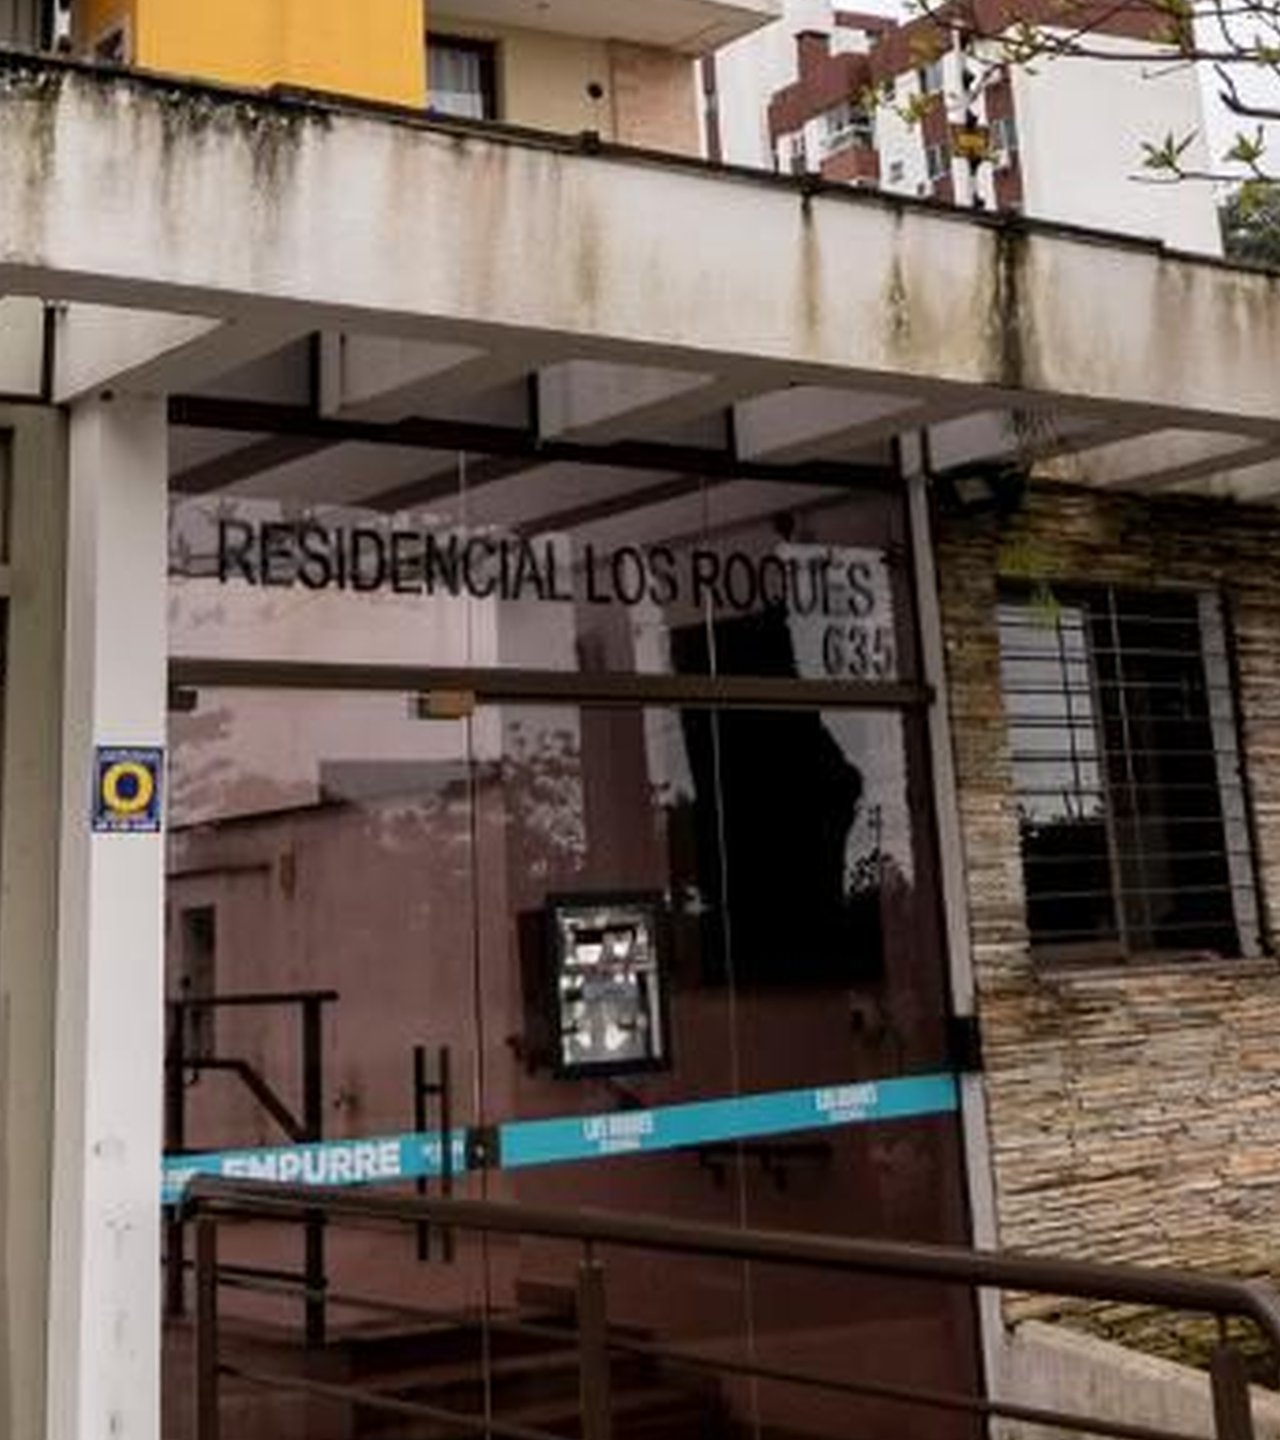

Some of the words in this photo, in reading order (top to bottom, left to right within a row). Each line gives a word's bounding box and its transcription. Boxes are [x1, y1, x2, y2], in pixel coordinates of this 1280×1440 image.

[219, 519, 573, 602] RESIDENCIAL
[585, 543, 678, 605] LOS
[691, 550, 874, 617] ROQUES
[823, 624, 894, 677] 635
[220, 1140, 401, 1185] EMPURRE
